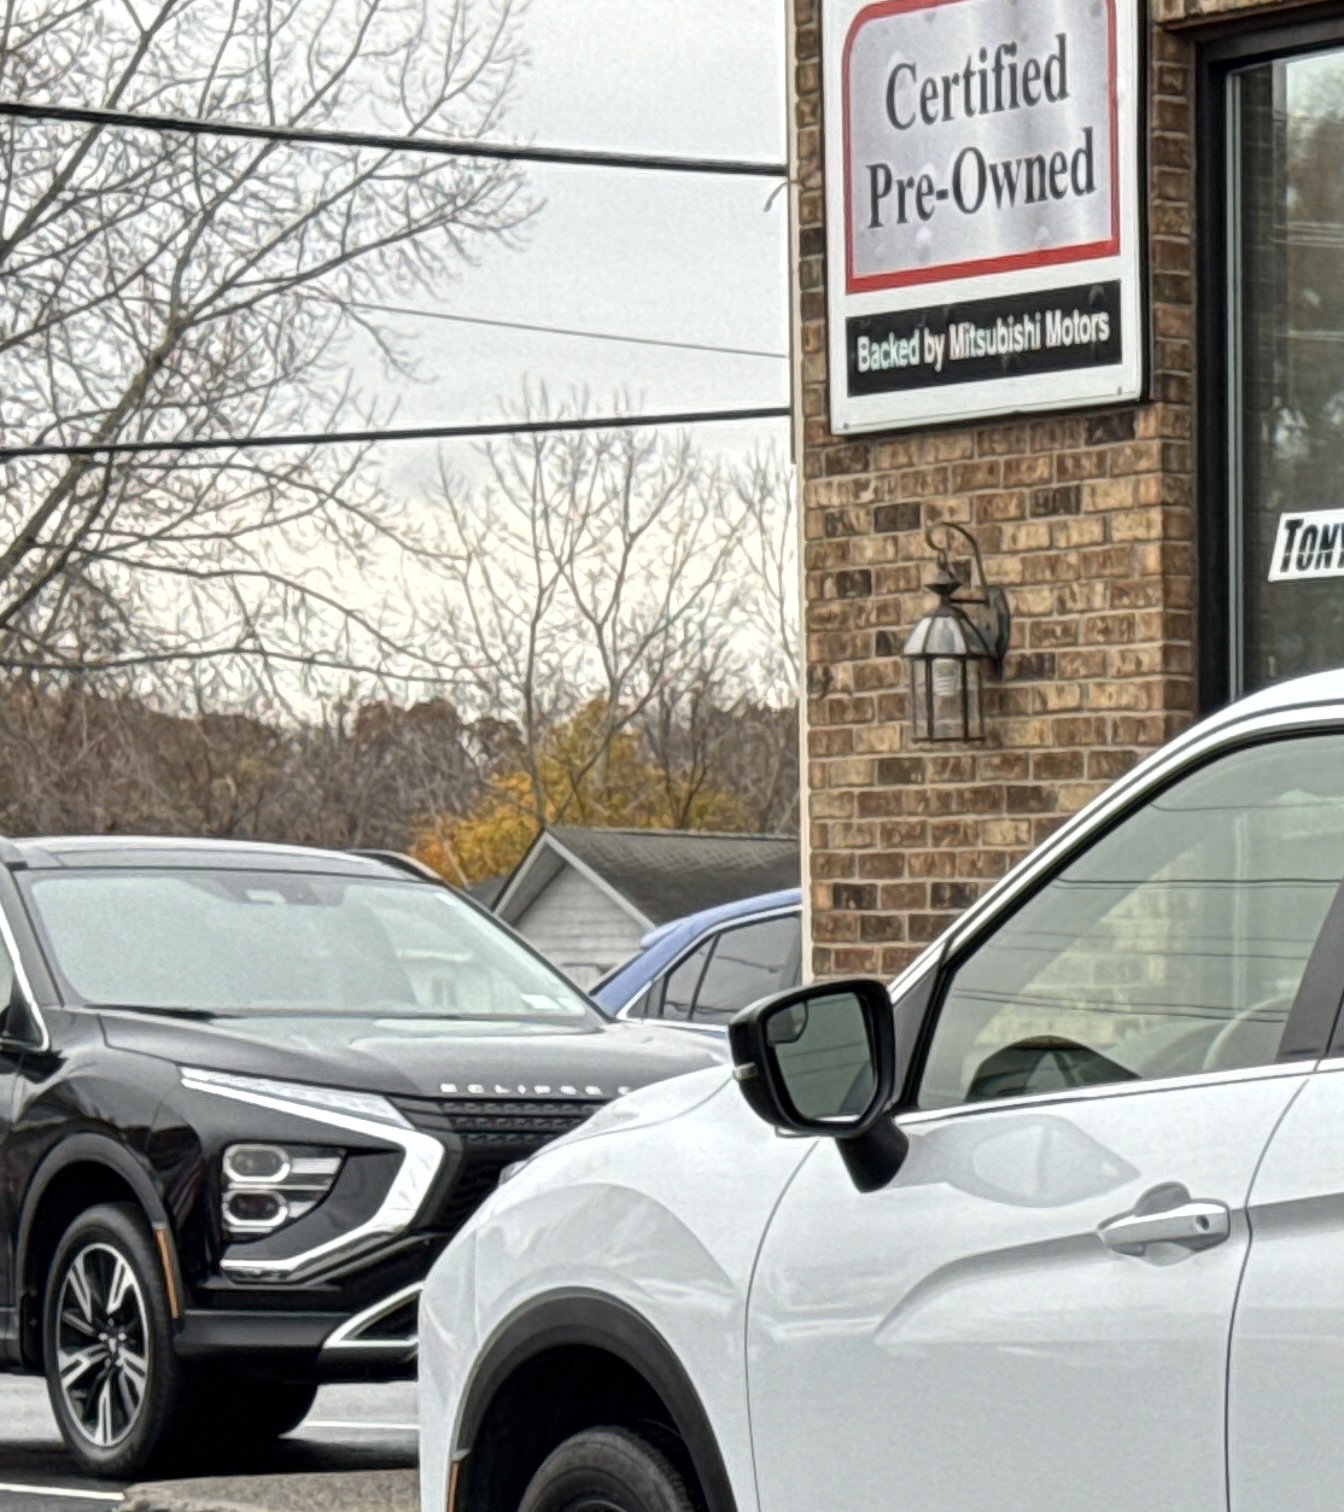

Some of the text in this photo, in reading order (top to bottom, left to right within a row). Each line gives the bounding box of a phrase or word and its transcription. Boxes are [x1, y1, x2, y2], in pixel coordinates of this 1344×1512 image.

[886, 33, 1069, 130] Certified
[866, 126, 1096, 229] Pre-Owned
[857, 309, 1110, 372] Backed by Mitsubishi Motors
